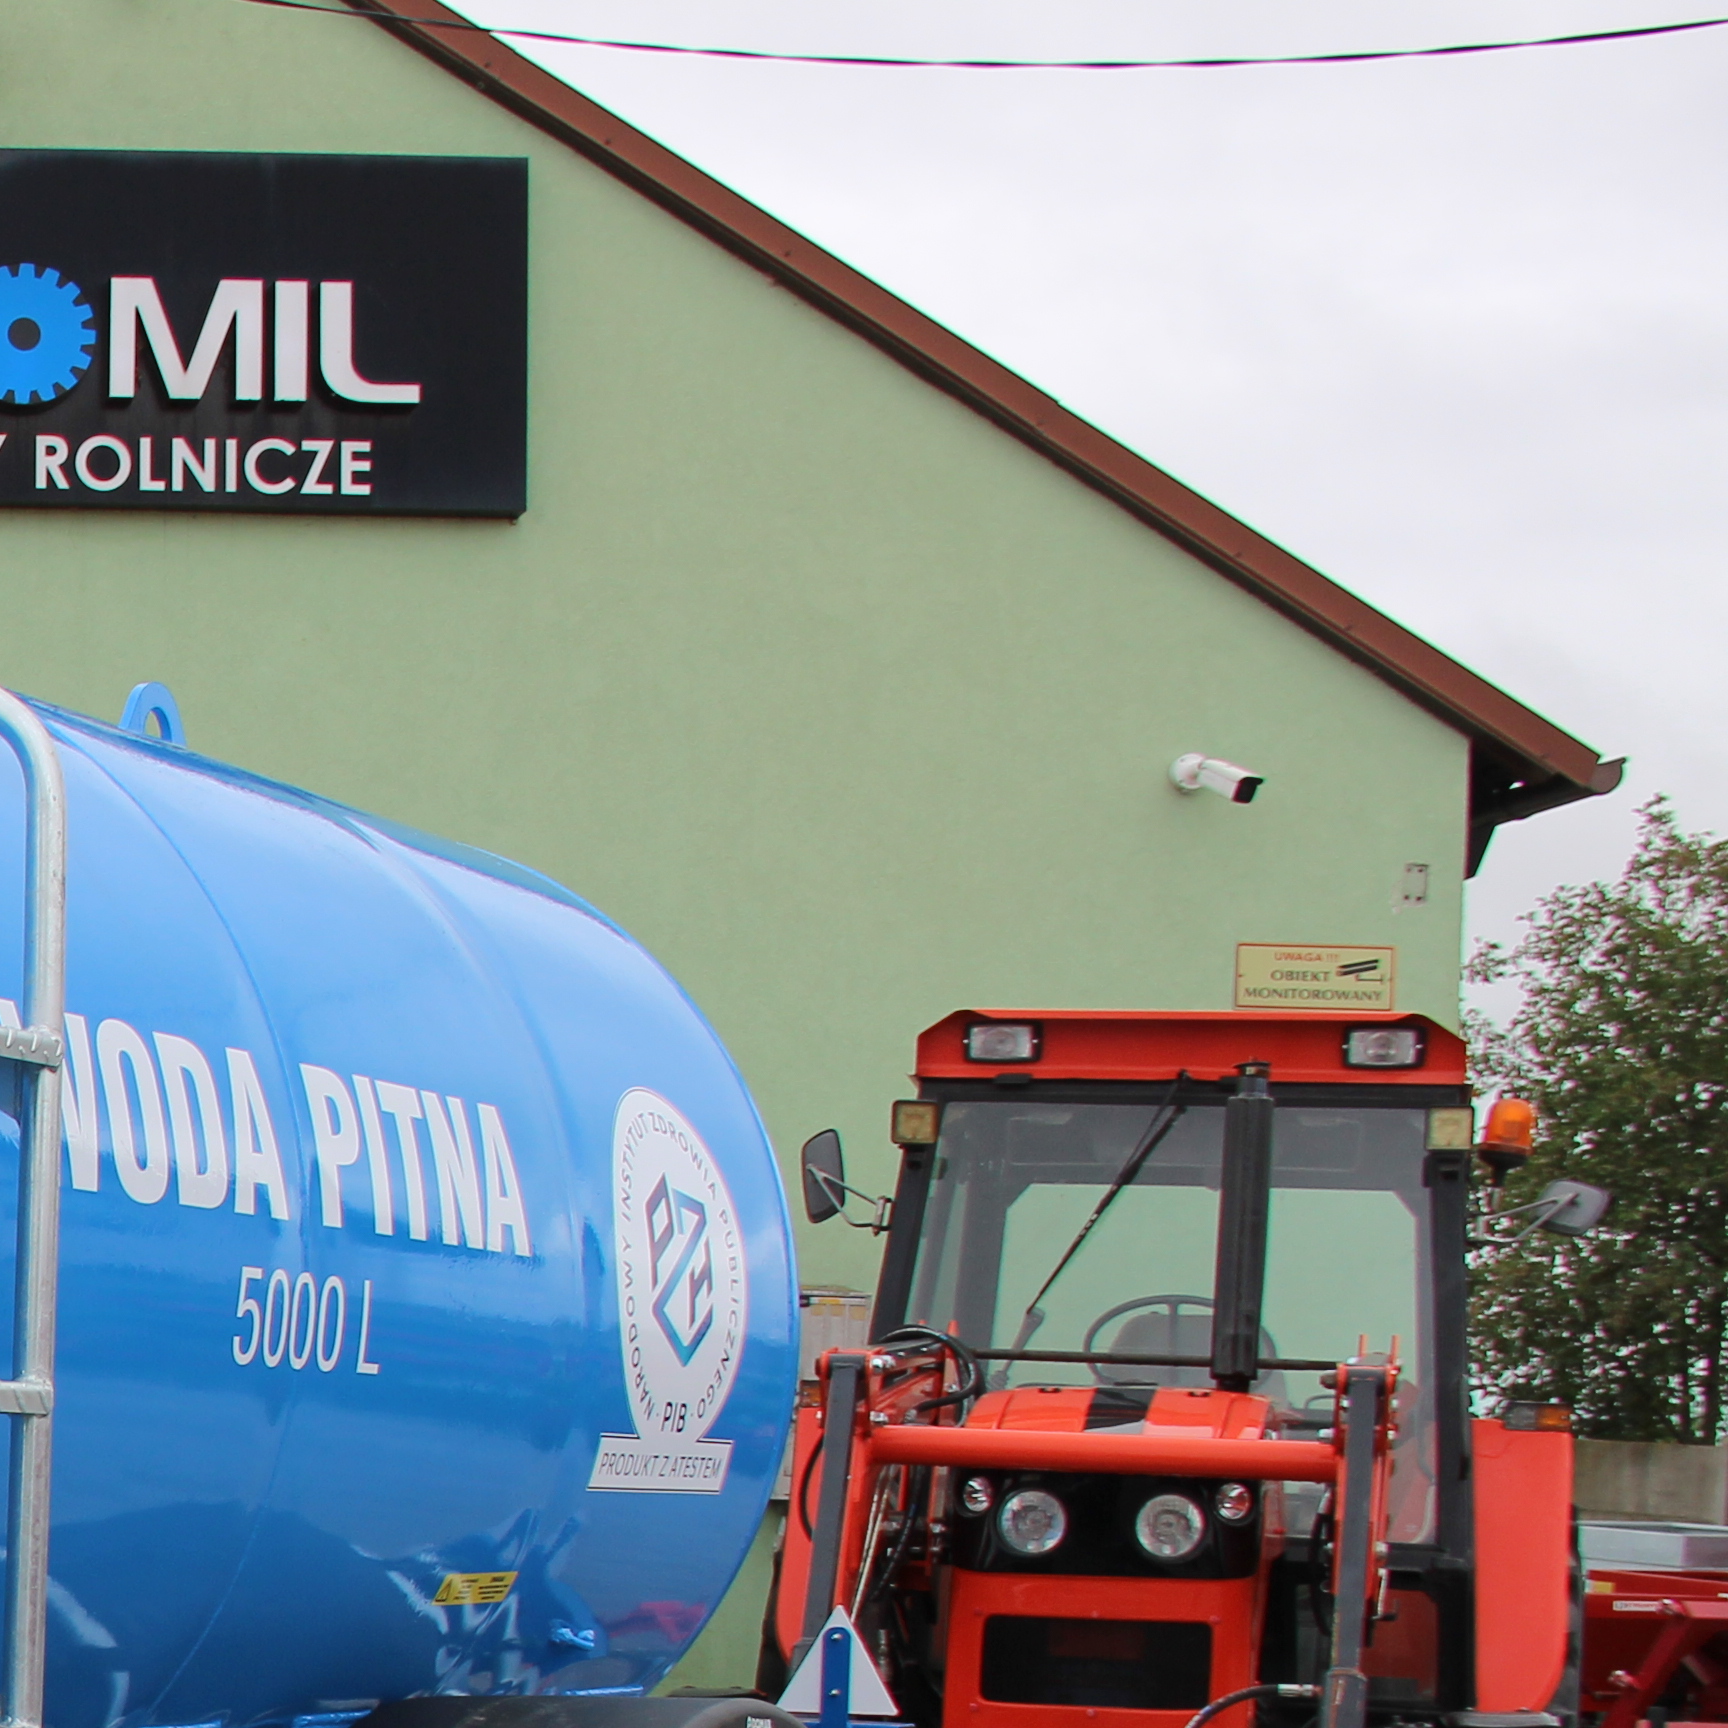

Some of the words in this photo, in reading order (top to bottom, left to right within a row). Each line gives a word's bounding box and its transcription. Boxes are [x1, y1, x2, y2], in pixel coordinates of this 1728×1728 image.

[33, 434, 373, 498] ROLNICZE
[1244, 987, 1383, 1001] MONITOROWANY
[1270, 969, 1332, 982] OBIEKT
[1274, 952, 1323, 962] UWAGA
[298, 1062, 533, 1258] PITNA
[619, 1112, 649, 1222] INSTYTUT
[647, 1111, 716, 1201] ZDROWIA
[231, 1265, 344, 1374] 5000
[354, 1280, 381, 1376] L
[620, 1236, 655, 1422] NARODOWY
[696, 1208, 742, 1420] PUBLICZNEGO
[659, 1400, 688, 1434] PIB
[600, 1451, 658, 1477] PRODUKT
[658, 1455, 668, 1477] Z
[668, 1455, 723, 1480] ATESTEM
